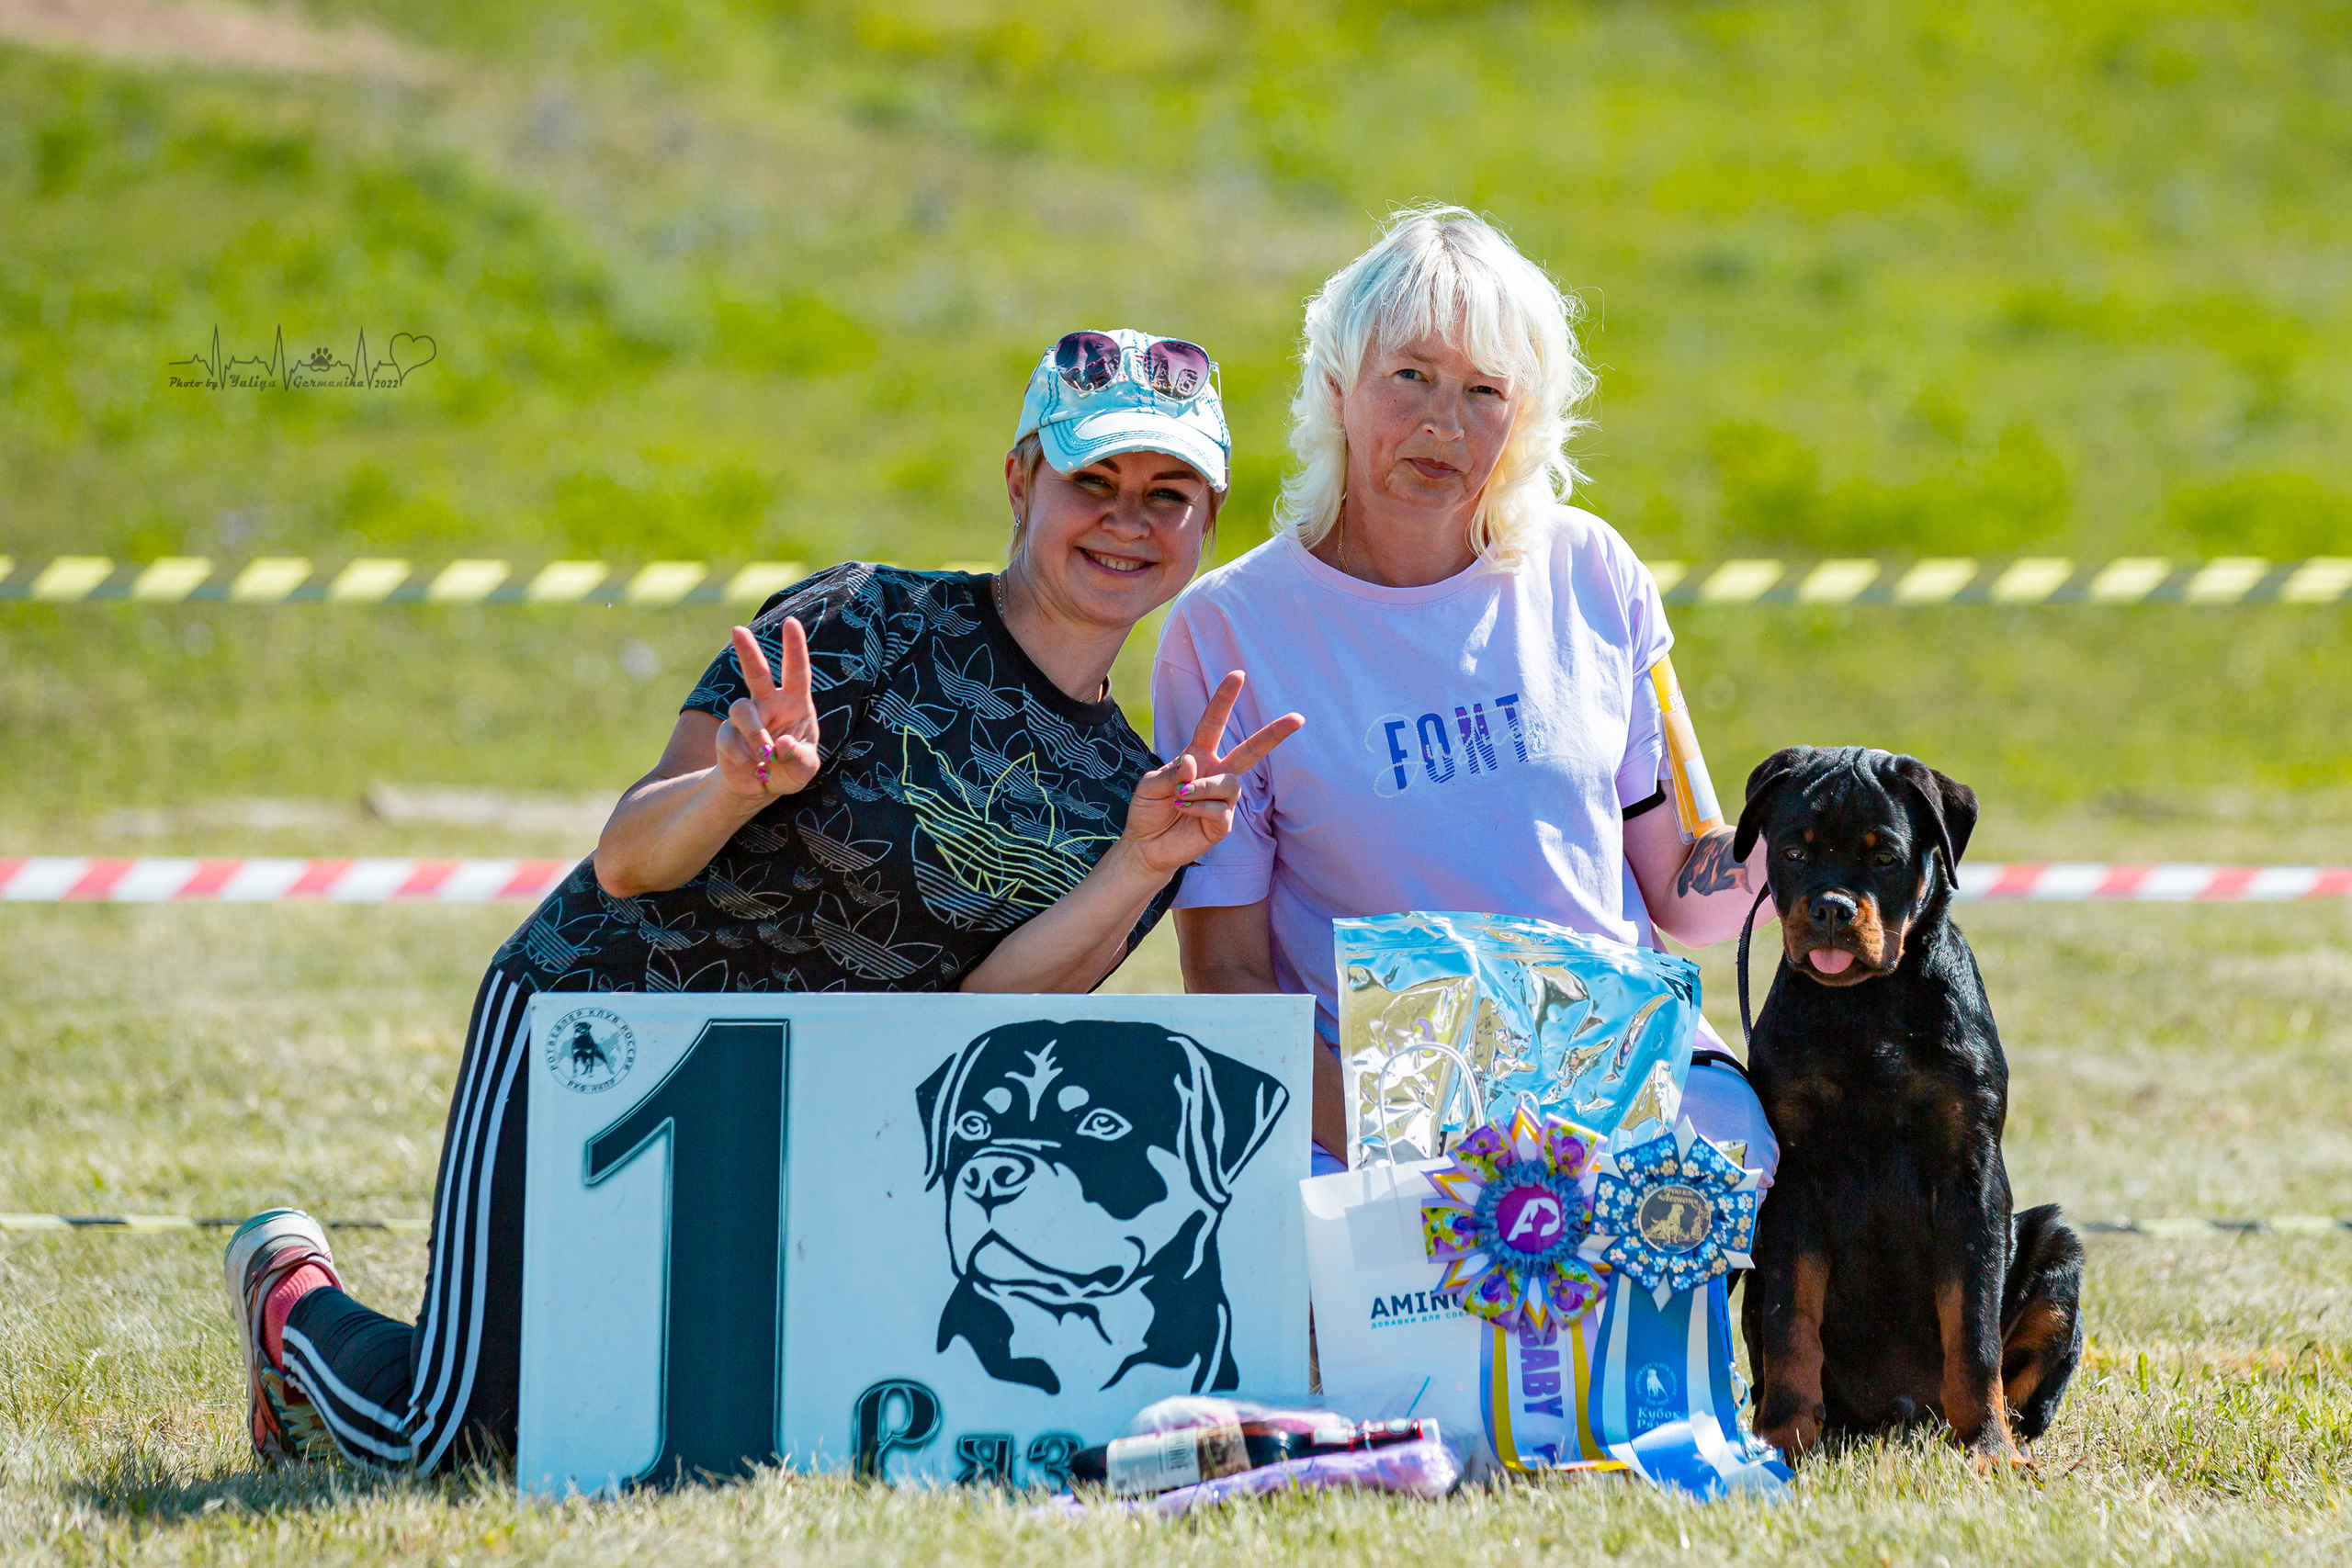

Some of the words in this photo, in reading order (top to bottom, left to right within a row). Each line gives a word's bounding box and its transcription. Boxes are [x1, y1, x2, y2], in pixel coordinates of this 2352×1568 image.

[588, 1010, 620, 1024] КЛУБ
[583, 1018, 791, 1493] 1
[1371, 1317, 1417, 1329] ДОБАВКИ
[1421, 1314, 1441, 1323] ДЛЯ
[1638, 1406, 1680, 1422] Кубок
